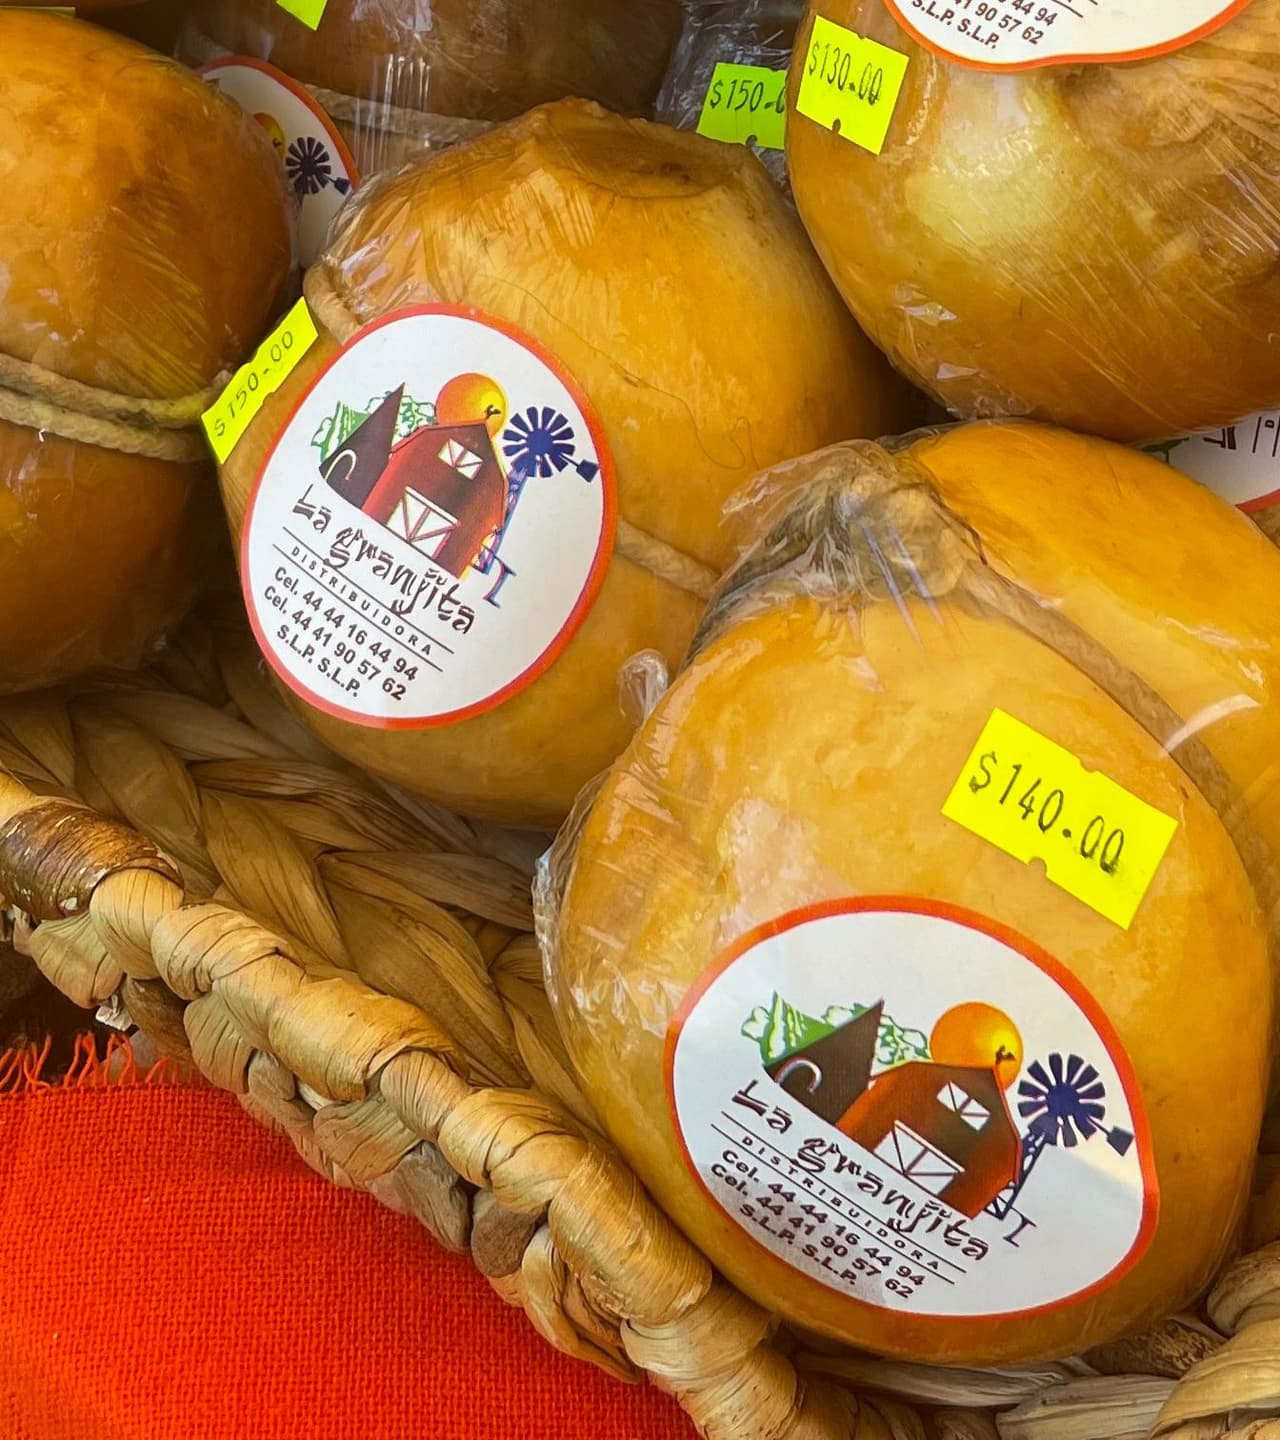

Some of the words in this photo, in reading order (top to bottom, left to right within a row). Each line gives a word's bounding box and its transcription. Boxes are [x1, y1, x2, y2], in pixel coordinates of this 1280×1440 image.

[957, 18, 1000, 49] S.L.P.
[975, 2, 998, 21] 90
[998, 14, 1022, 32] 57
[1022, 26, 1044, 45] 62
[1035, 7, 1058, 26] 94
[291, 546, 431, 656] DISTRIBUIDORA
[292, 484, 332, 534] La
[322, 526, 475, 634] granjita
[264, 585, 287, 614] Cel.
[292, 610, 312, 630] 44
[312, 627, 333, 647] 41
[334, 643, 356, 664] 90
[357, 660, 380, 680] 57
[382, 678, 407, 700] 62
[274, 567, 298, 595] Cel.
[303, 591, 323, 611] 44
[324, 607, 345, 628] 44
[348, 624, 368, 644] 16
[370, 642, 392, 663] 44
[393, 660, 418, 681] 94
[277, 625, 315, 663] S.L.P.
[318, 658, 360, 697] S.L.P.
[969, 752, 1125, 875] $140.00
[722, 1149, 759, 1182] Cel.
[768, 1183, 794, 1203] 44
[800, 1203, 828, 1224] 44
[835, 1224, 861, 1245] 16
[864, 1247, 892, 1266] 44
[896, 1264, 925, 1286] 94
[732, 1079, 793, 1134] La
[790, 1137, 989, 1260] granjita
[742, 1136, 939, 1270] DISTRIBUIDORA
[711, 1164, 748, 1195] Cel.
[756, 1196, 784, 1215] 44
[789, 1214, 815, 1235] 41
[821, 1235, 849, 1257] 90
[852, 1257, 882, 1277] 57
[885, 1277, 914, 1298] 62
[739, 1204, 796, 1245] S.L.P.
[802, 1245, 857, 1286] S.L.P.
